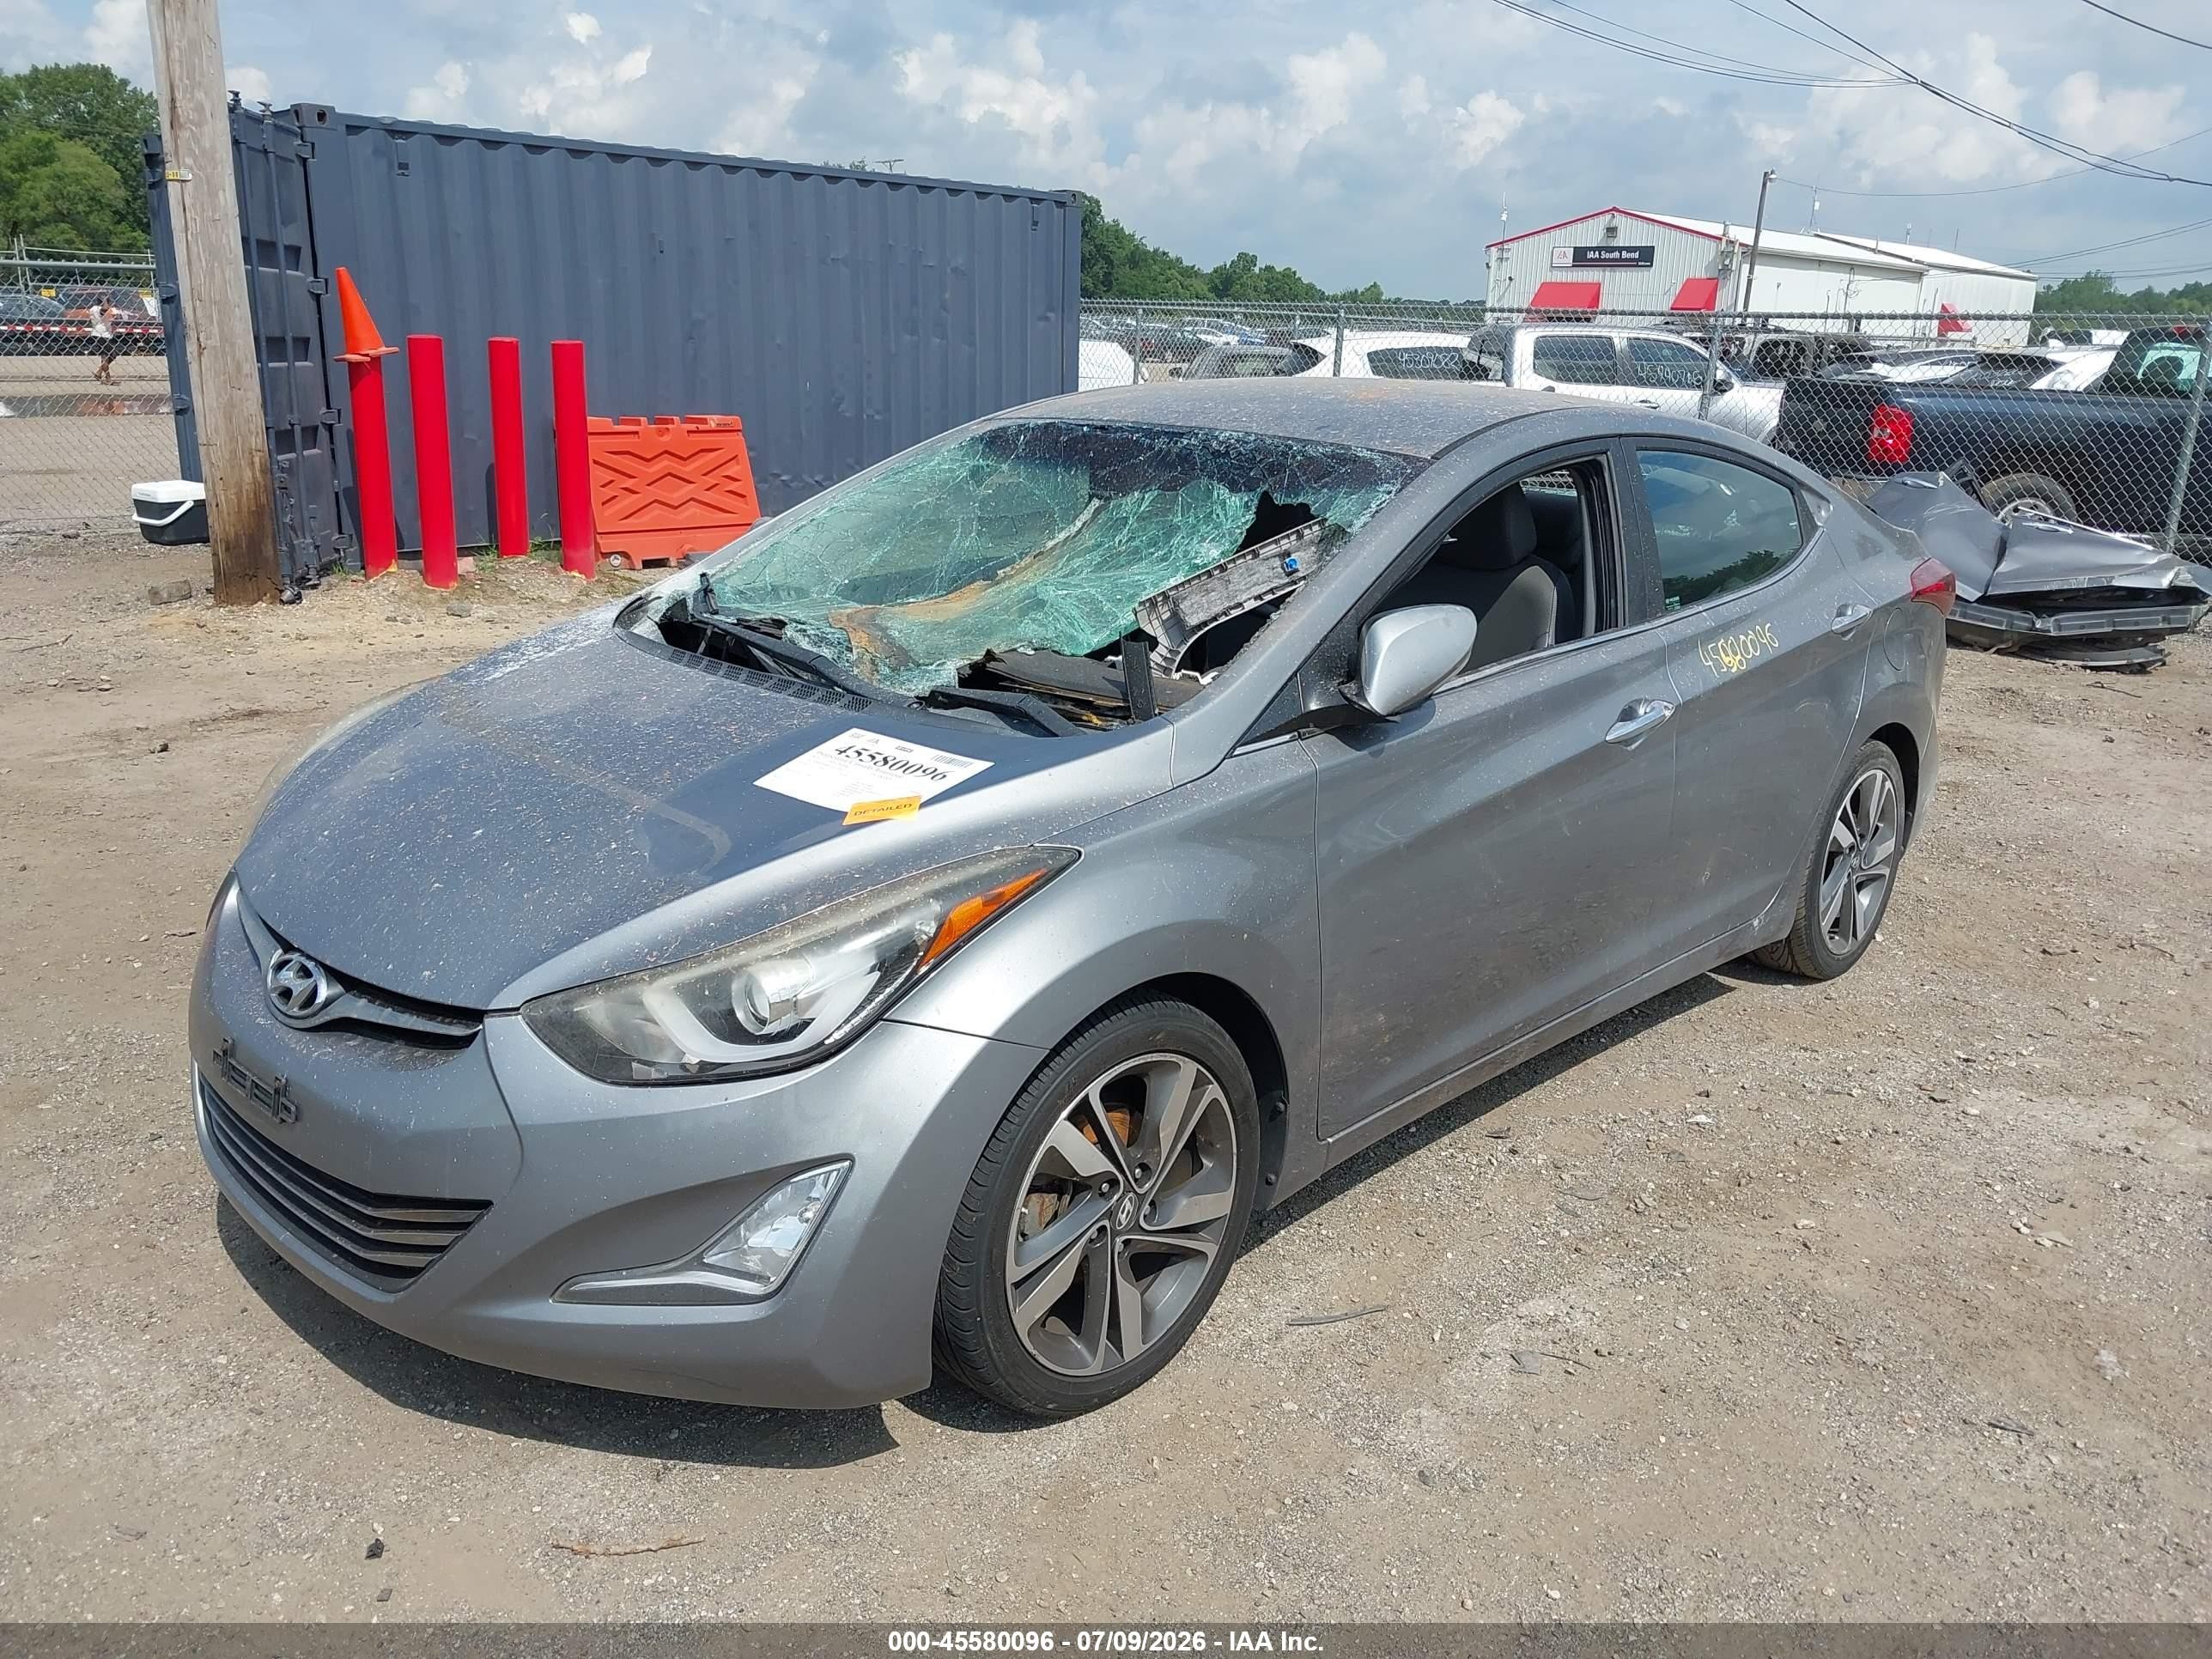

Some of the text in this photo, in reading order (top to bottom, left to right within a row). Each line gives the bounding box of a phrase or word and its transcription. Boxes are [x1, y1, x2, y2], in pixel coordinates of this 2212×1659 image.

[1586, 250, 1639, 259] IAA South Bend
[835, 744, 956, 781] 45580096
